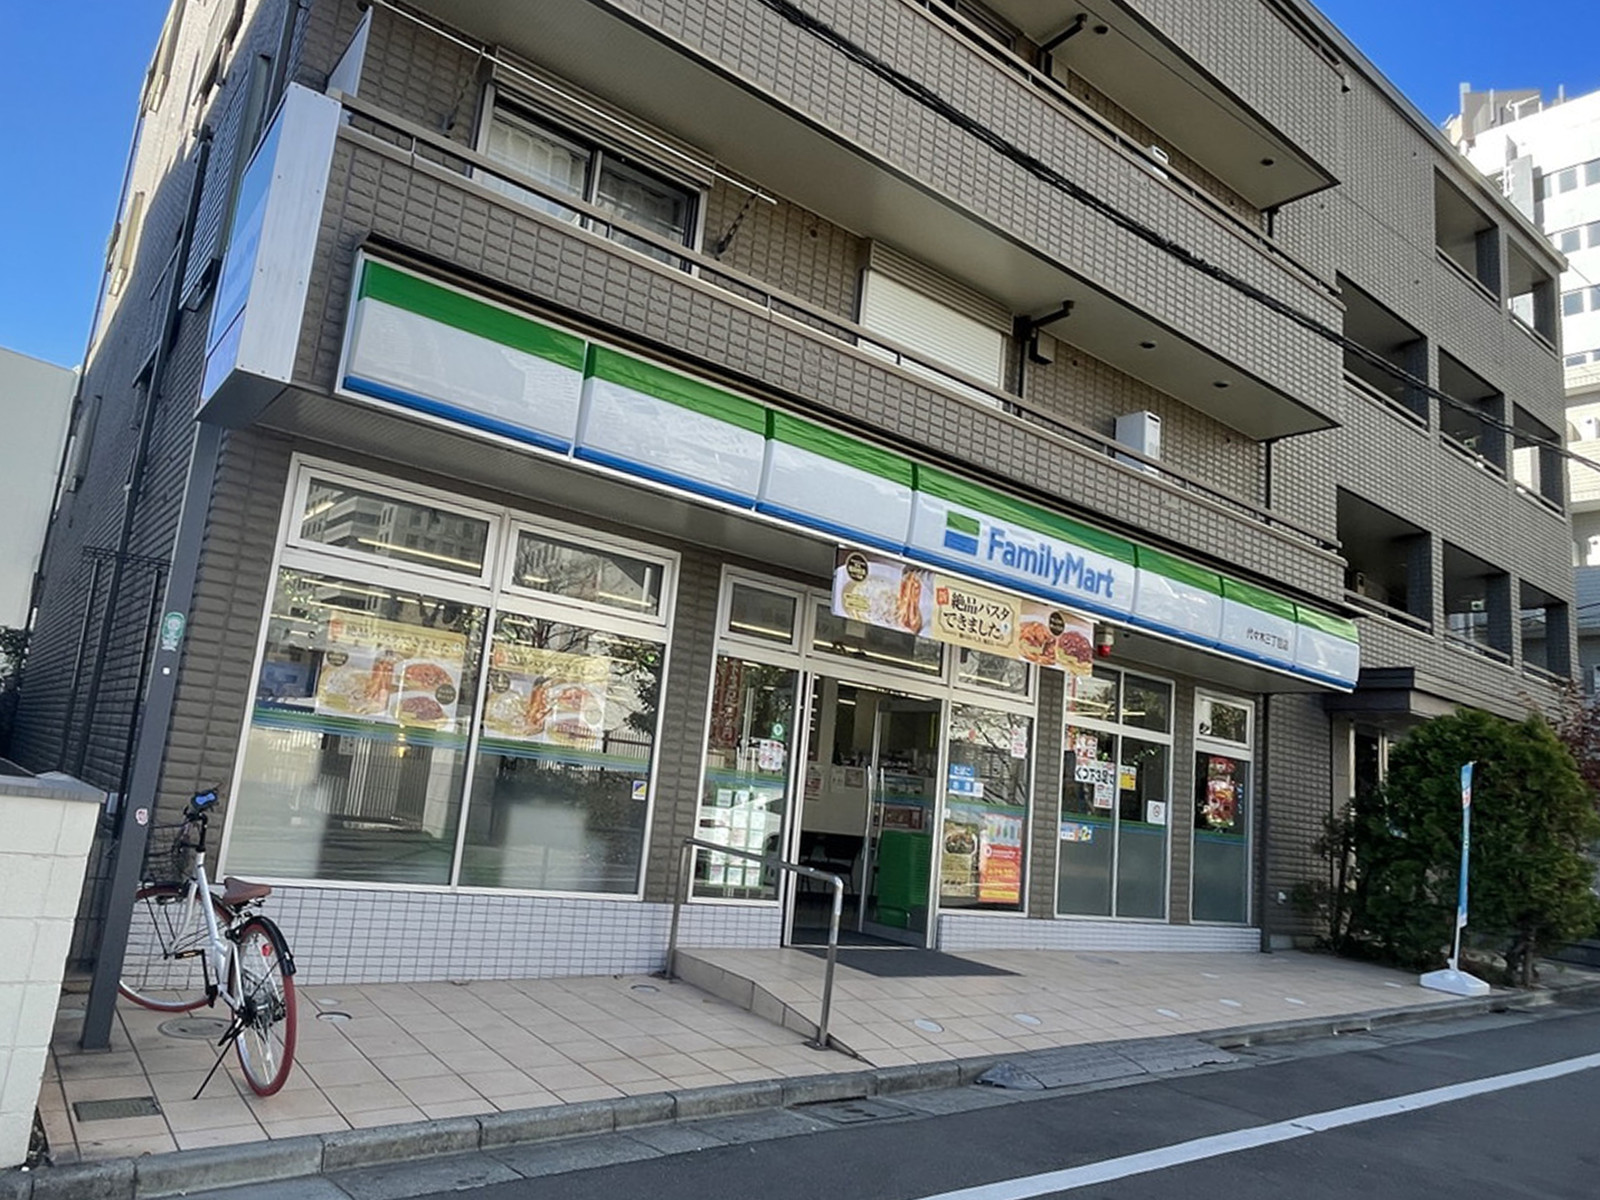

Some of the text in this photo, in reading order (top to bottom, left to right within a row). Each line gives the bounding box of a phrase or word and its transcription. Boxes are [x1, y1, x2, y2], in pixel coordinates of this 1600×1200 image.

[987, 526, 1114, 598] FamilyMart
[952, 592, 1010, 621] 絶品パスタ
